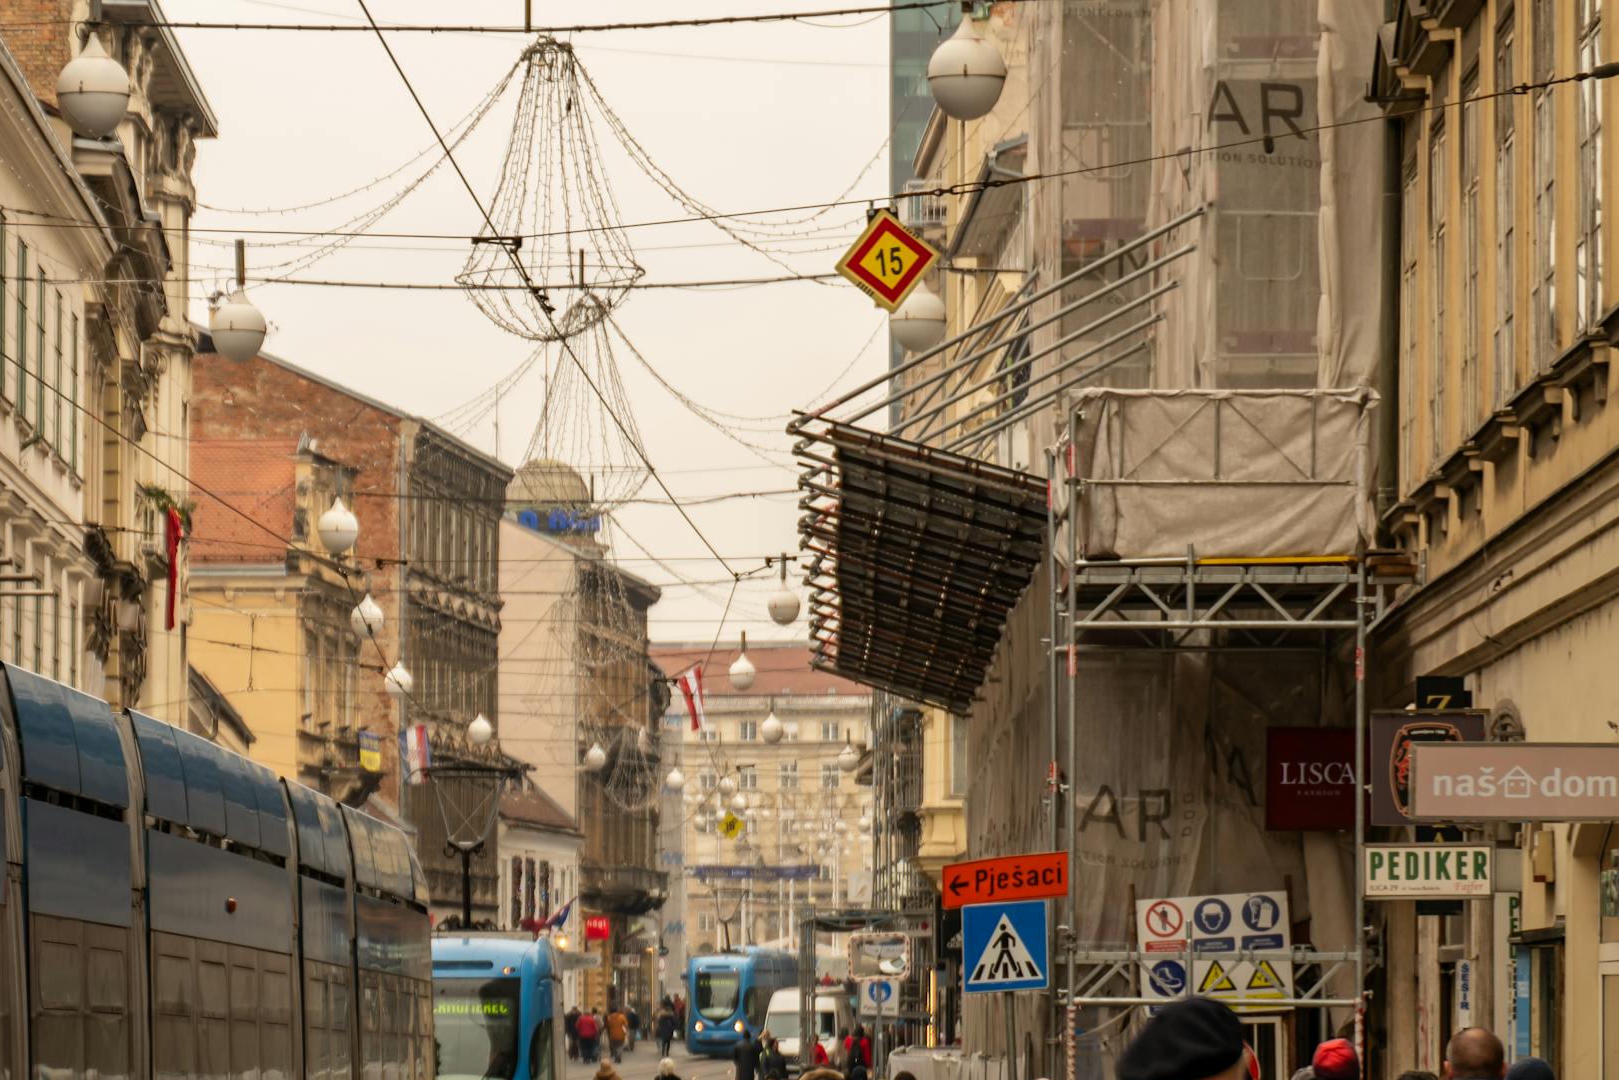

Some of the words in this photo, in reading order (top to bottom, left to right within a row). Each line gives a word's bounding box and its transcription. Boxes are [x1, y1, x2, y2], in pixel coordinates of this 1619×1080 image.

[1207, 80, 1307, 141] AR
[876, 247, 903, 277] 15
[1279, 762, 1356, 785] LISCA
[1433, 767, 1496, 797] naš
[1539, 767, 1617, 798] dom
[1078, 784, 1171, 842] AR
[975, 862, 1062, 896] Pješaci
[1370, 851, 1487, 880] PEDIKER
